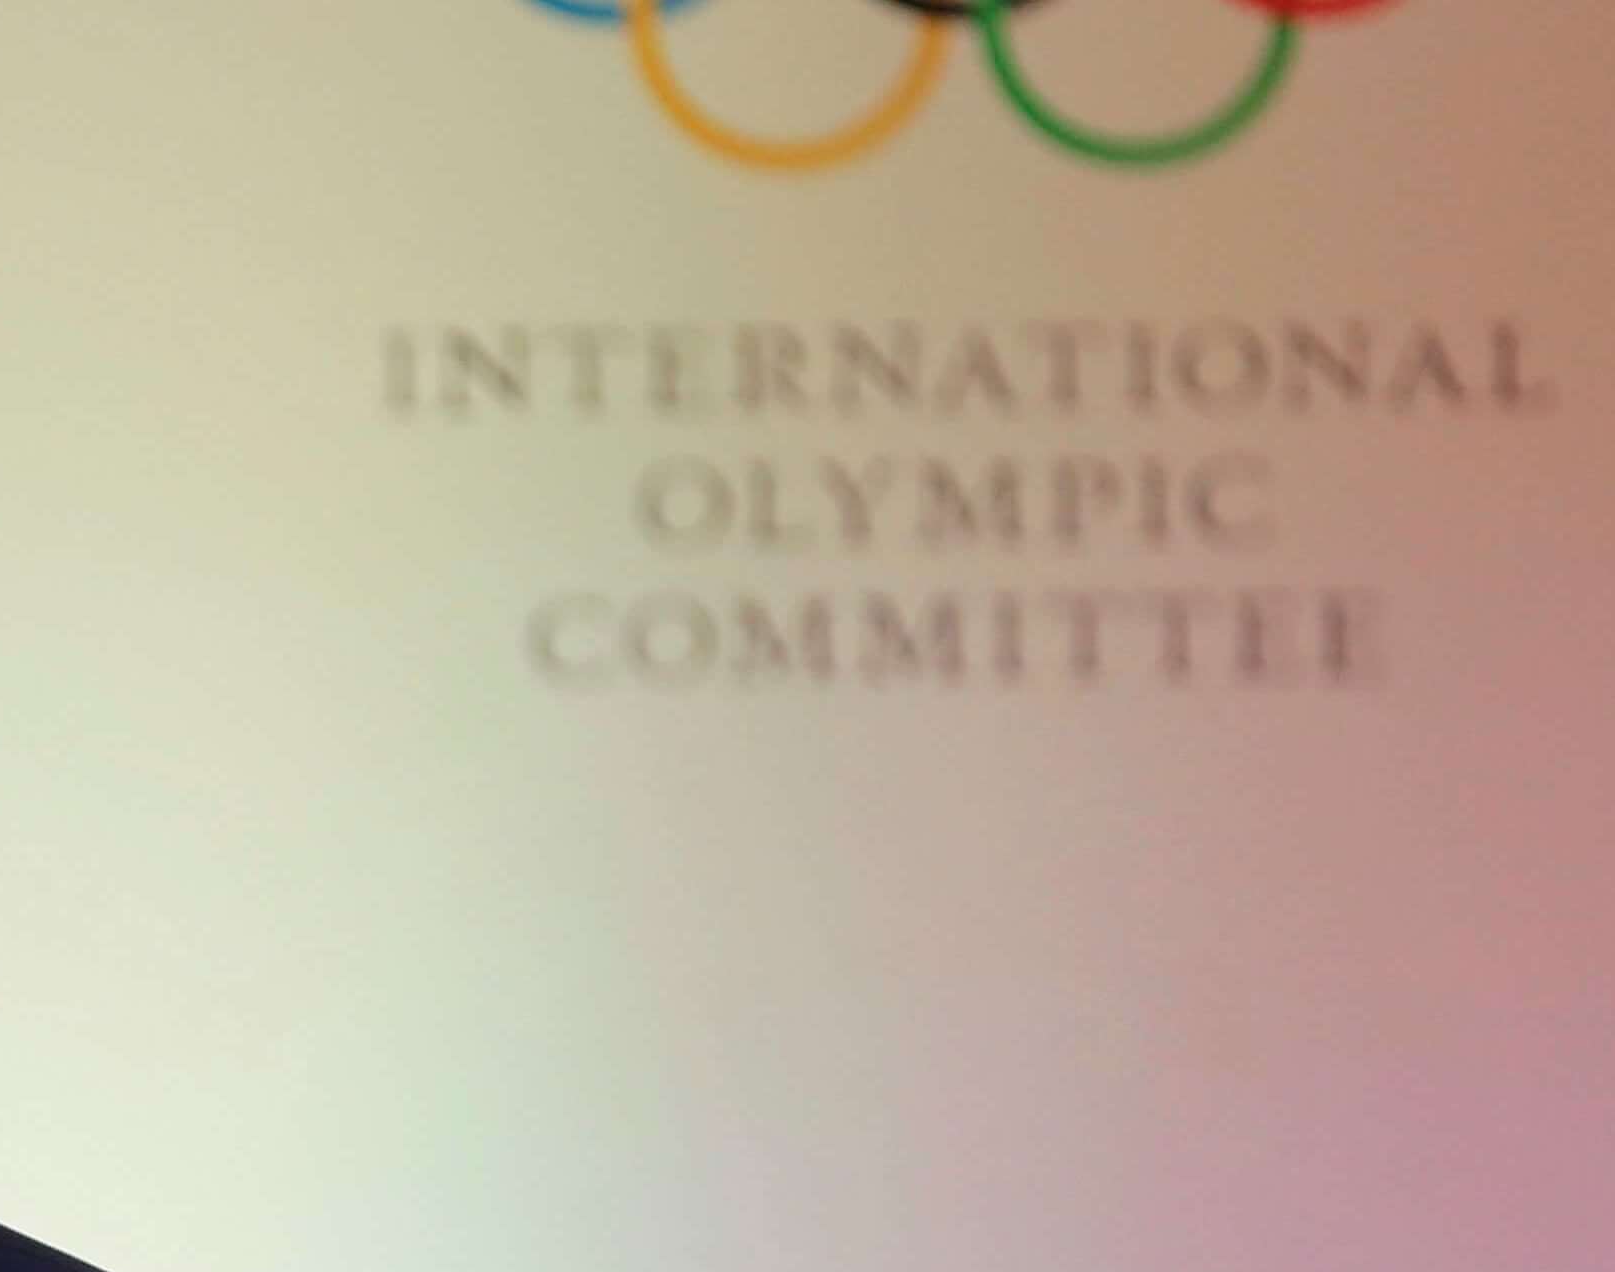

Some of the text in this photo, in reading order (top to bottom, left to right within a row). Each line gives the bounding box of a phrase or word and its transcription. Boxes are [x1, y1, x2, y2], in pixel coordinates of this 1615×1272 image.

[379, 318, 1561, 422] INTERNATIONAL
[631, 450, 1276, 556] OLYMPIC
[521, 586, 1386, 690] COMMITTEE
